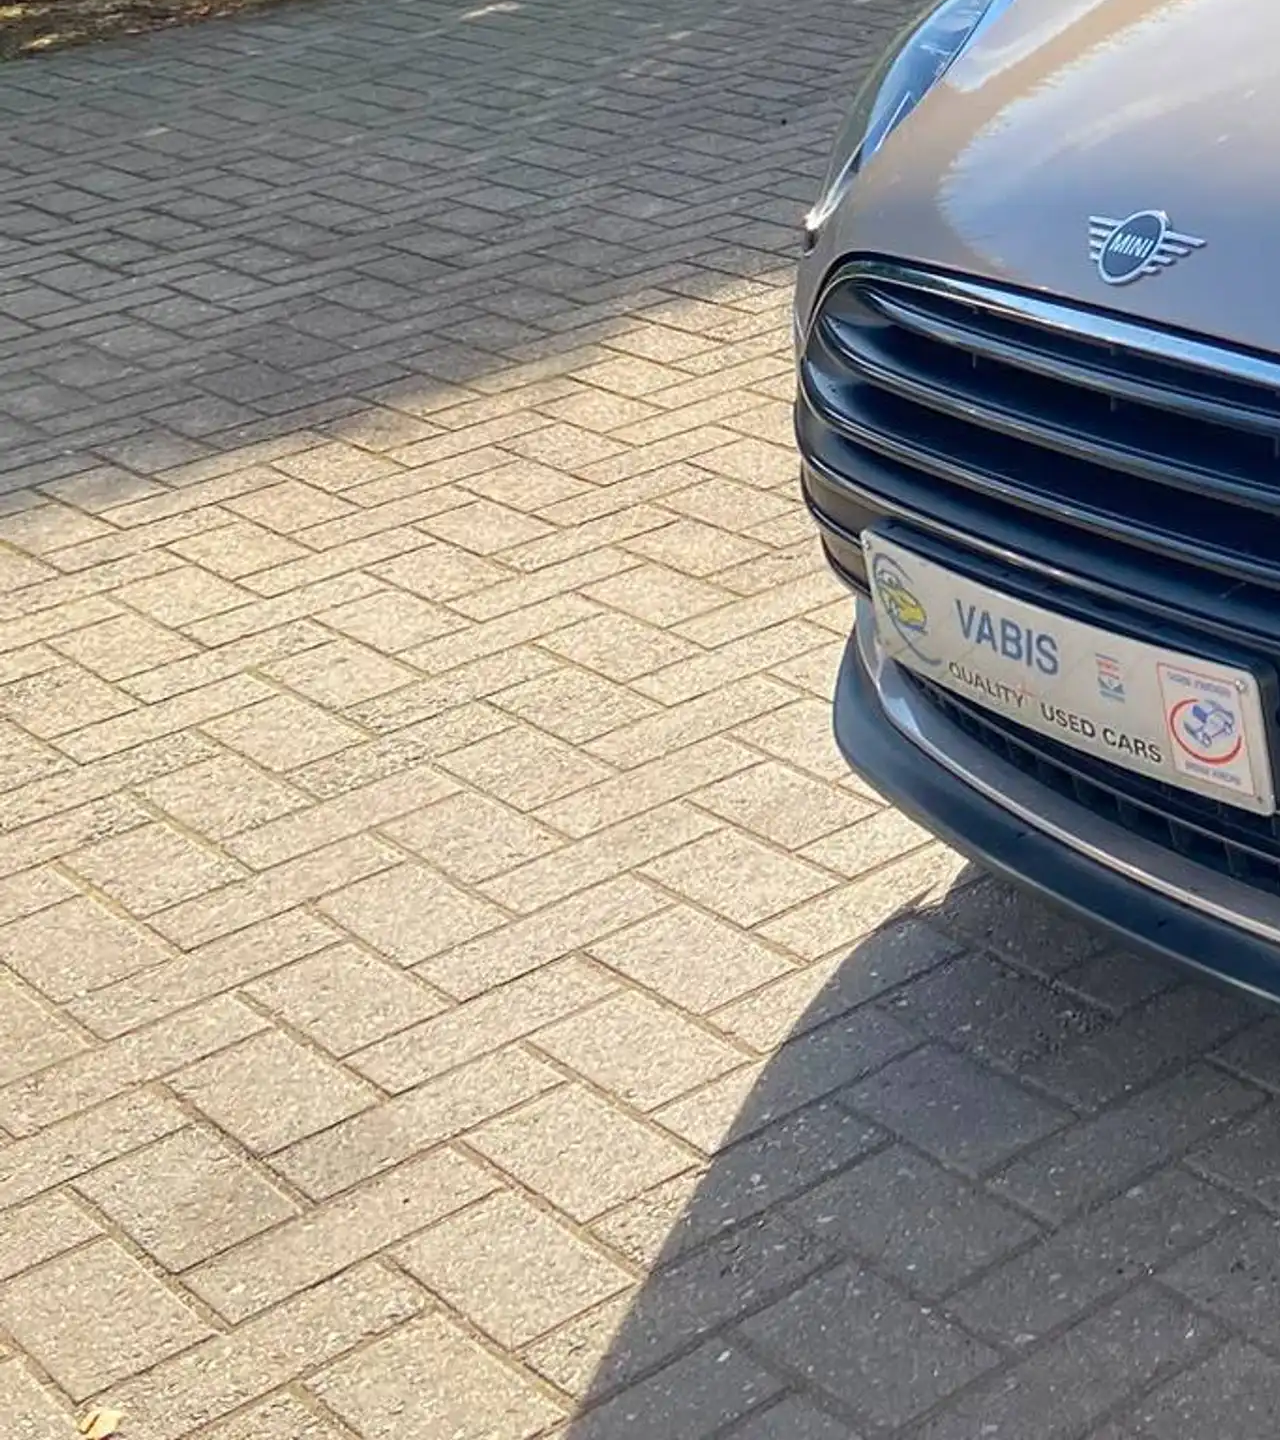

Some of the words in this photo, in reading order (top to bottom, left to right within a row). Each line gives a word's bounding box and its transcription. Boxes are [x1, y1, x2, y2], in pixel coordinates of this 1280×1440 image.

[1110, 233, 1154, 258] MINI
[956, 598, 1059, 676] VABIS
[949, 662, 1024, 708] QUALITY
[1040, 702, 1096, 738] USED
[1102, 727, 1162, 763] CARS
